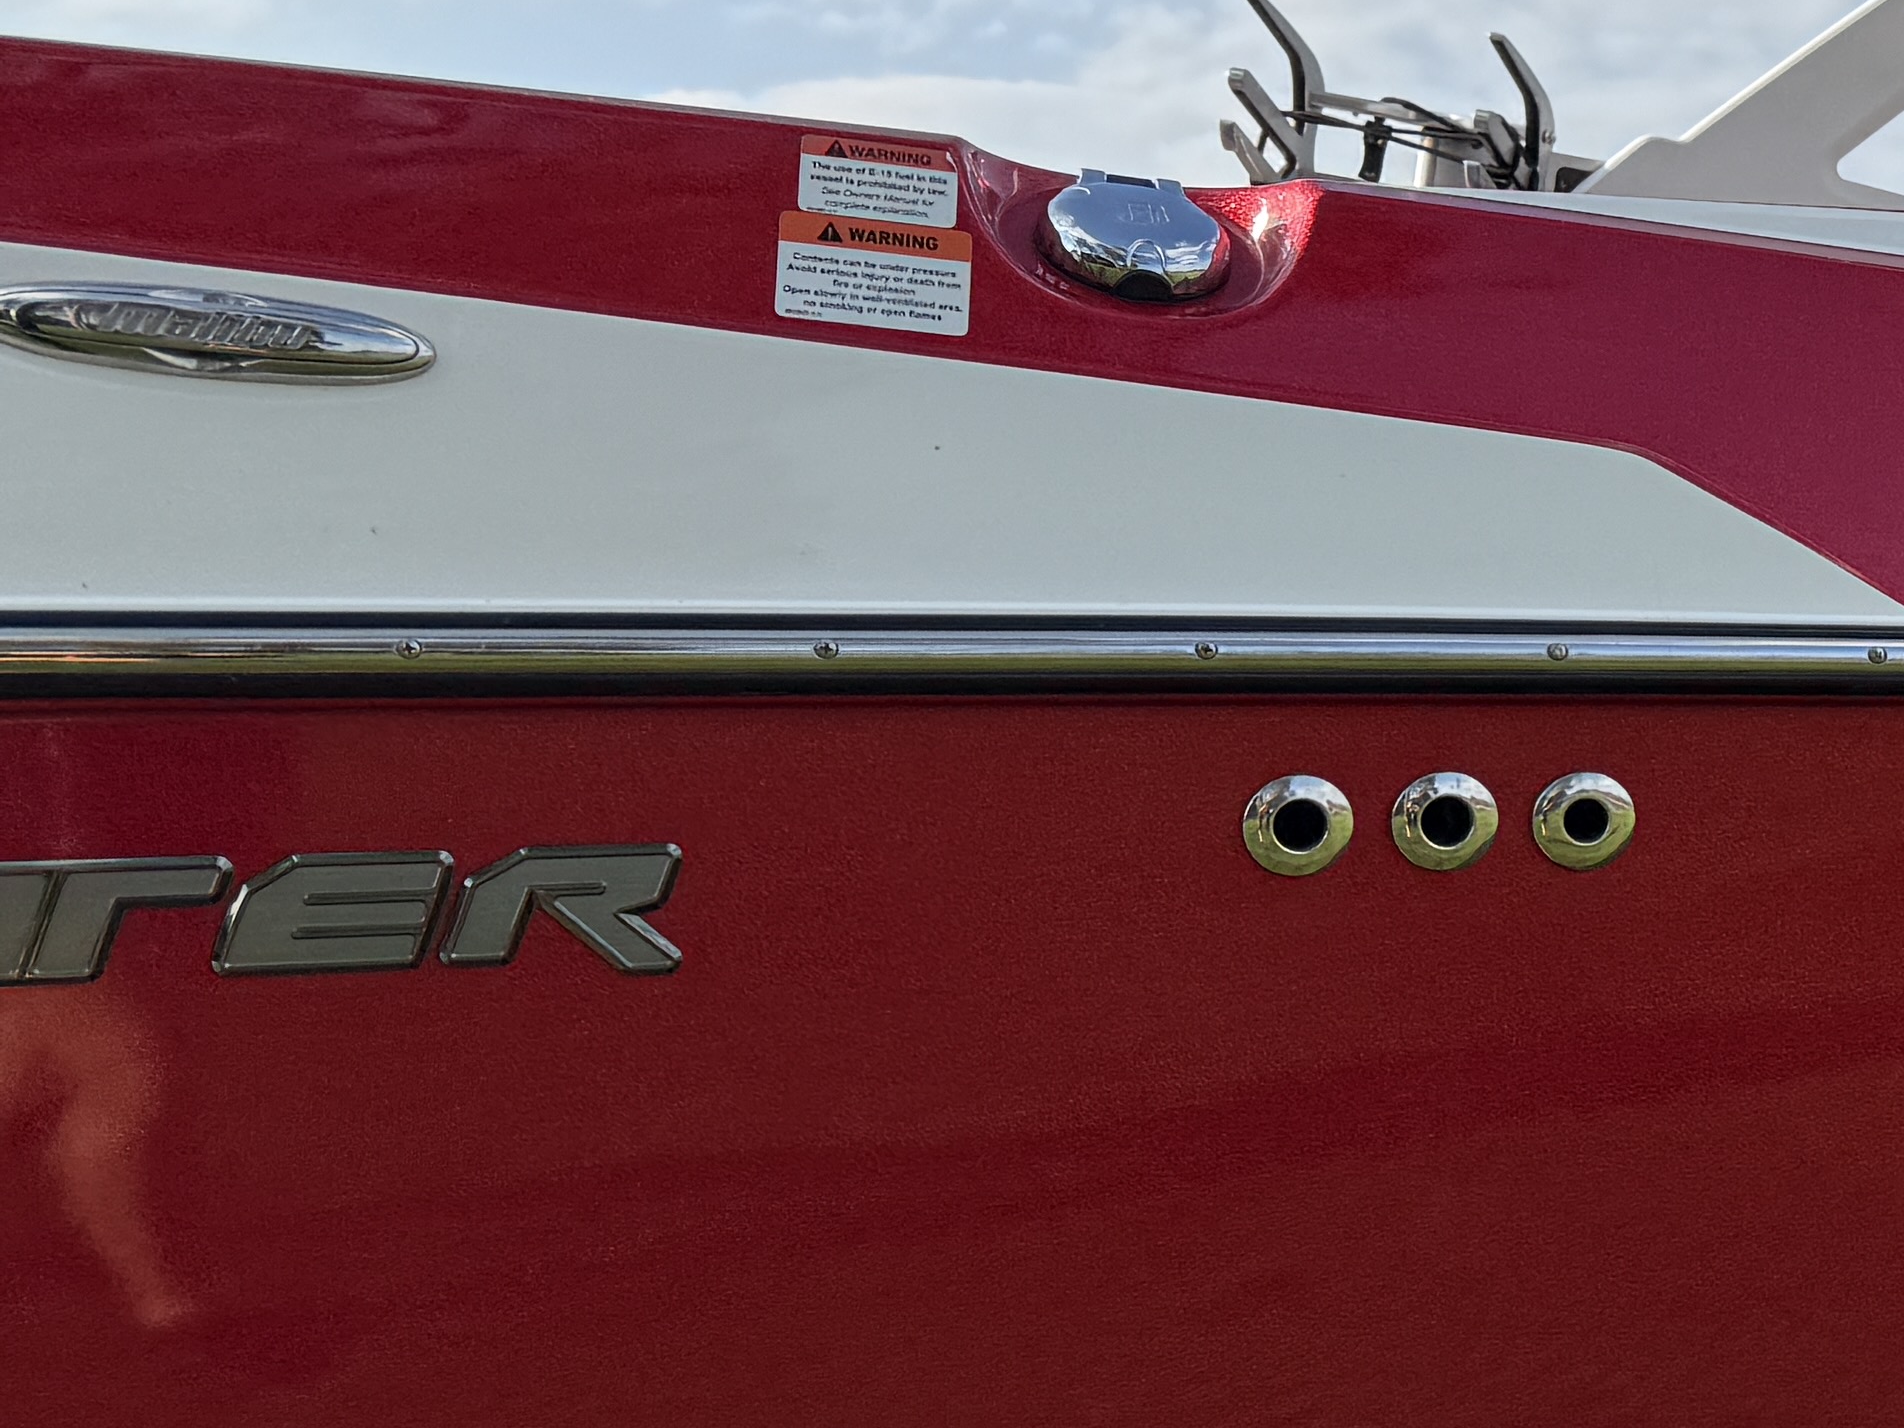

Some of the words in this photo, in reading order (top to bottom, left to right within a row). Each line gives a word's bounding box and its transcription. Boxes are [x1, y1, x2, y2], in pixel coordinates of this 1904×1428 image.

[849, 145, 931, 166] WARNING
[848, 227, 938, 251] WARNING
[0, 842, 683, 988] TER
